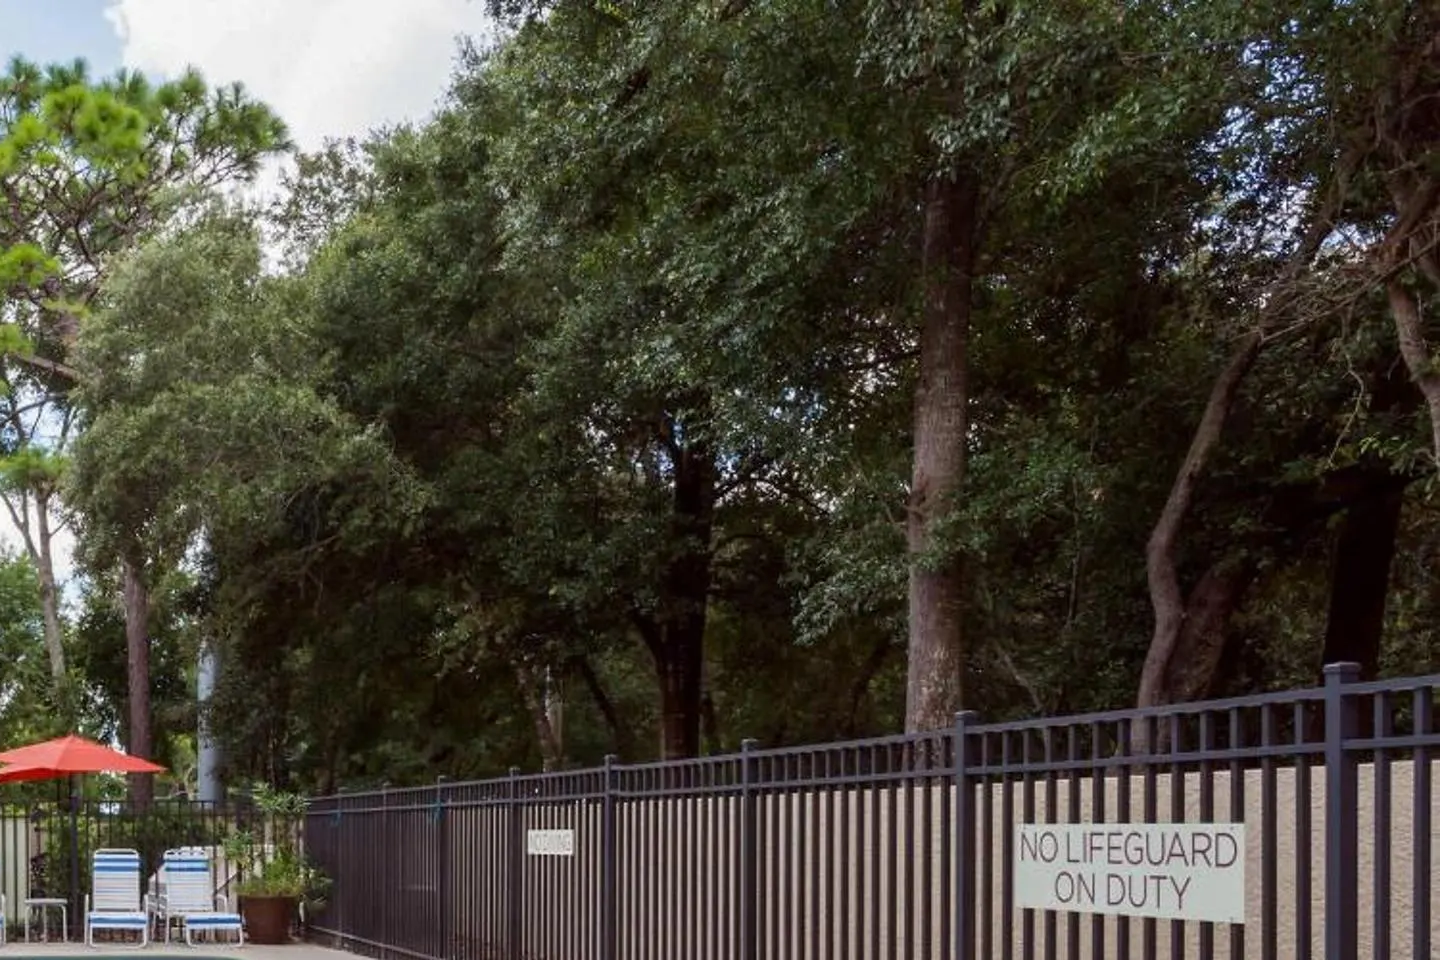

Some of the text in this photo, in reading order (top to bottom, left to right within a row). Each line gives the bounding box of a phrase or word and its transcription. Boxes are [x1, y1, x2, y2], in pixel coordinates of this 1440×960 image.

[1020, 831, 1238, 868] NO LIFEGUARD
[1055, 871, 1191, 910] ON DUTY
